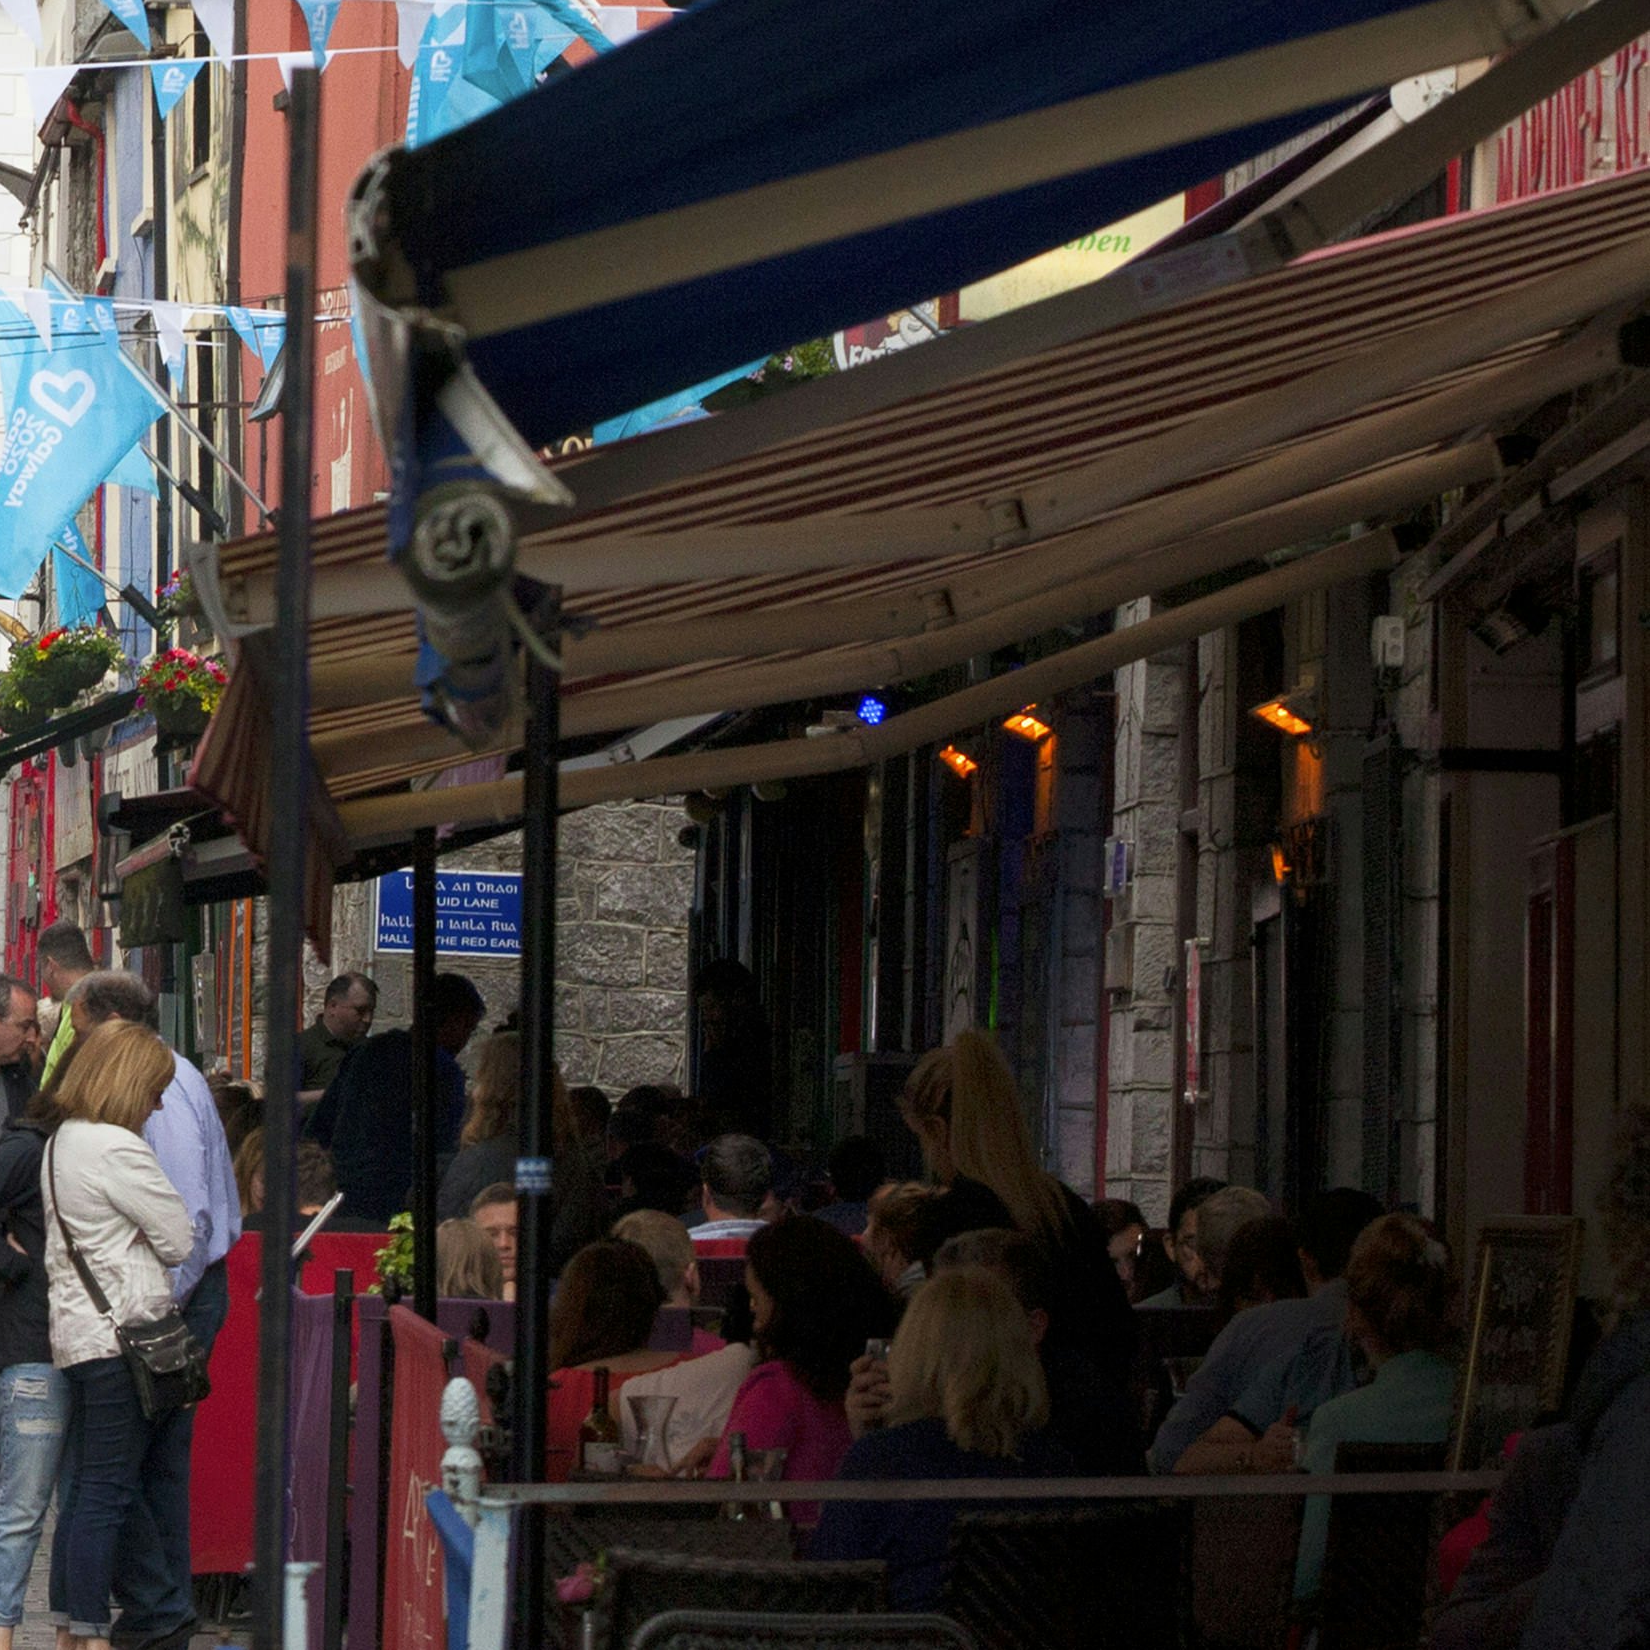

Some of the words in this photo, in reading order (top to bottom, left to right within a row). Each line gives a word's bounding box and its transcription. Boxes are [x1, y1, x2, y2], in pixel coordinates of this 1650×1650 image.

[436, 896, 461, 907] UID
[463, 897, 500, 909] LANE
[379, 933, 410, 945] HALL
[435, 935, 458, 947] THE
[461, 936, 488, 948] RED
[490, 938, 521, 949] EARL
